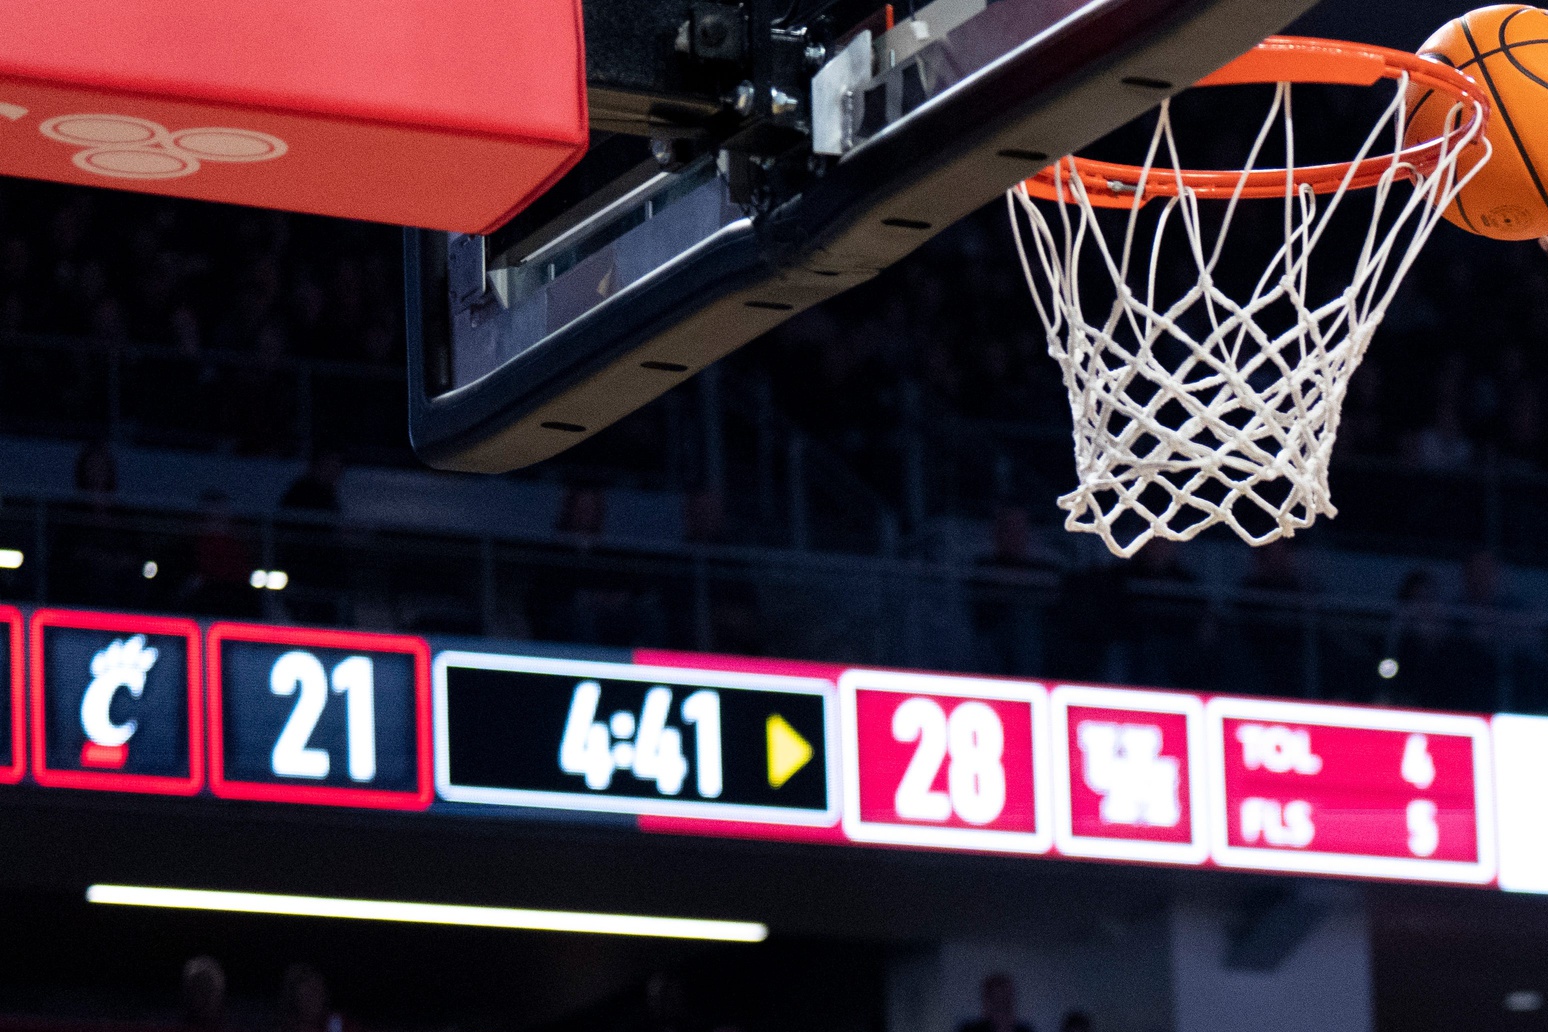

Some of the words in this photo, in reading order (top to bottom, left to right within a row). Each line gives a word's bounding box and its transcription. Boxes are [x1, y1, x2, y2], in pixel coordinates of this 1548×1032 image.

[270, 652, 376, 782] 21
[559, 681, 724, 799] 4:41
[892, 697, 1006, 825] 28
[1240, 797, 1315, 848] FLS
